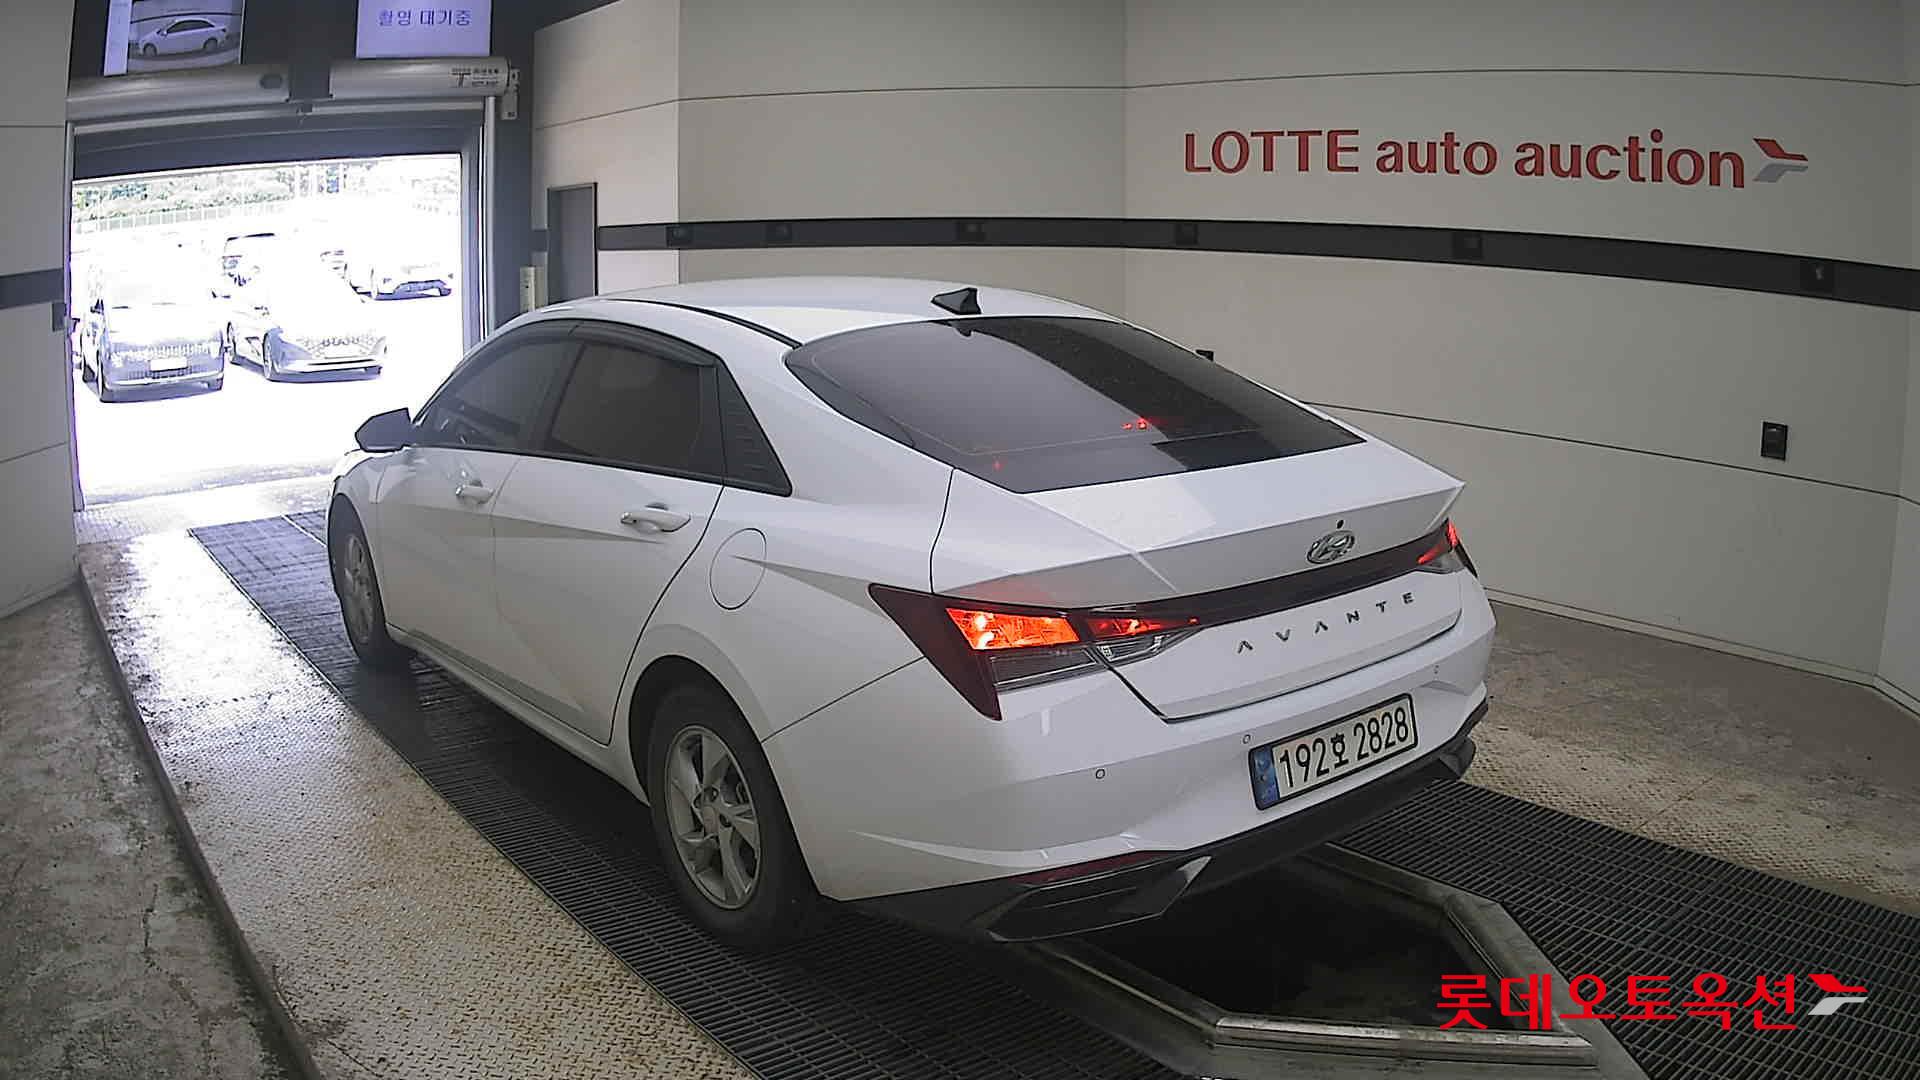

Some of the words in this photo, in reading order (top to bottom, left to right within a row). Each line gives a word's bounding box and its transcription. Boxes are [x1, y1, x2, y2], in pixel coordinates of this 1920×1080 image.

[420, 9, 471, 26] 대기중
[1184, 129, 1360, 174] LOTTE
[1375, 131, 1499, 176] auto
[1514, 129, 1745, 188] auction
[1237, 591, 1415, 655] AVANTE
[1279, 733, 1349, 788] 192호
[1353, 706, 1409, 761] 2828
